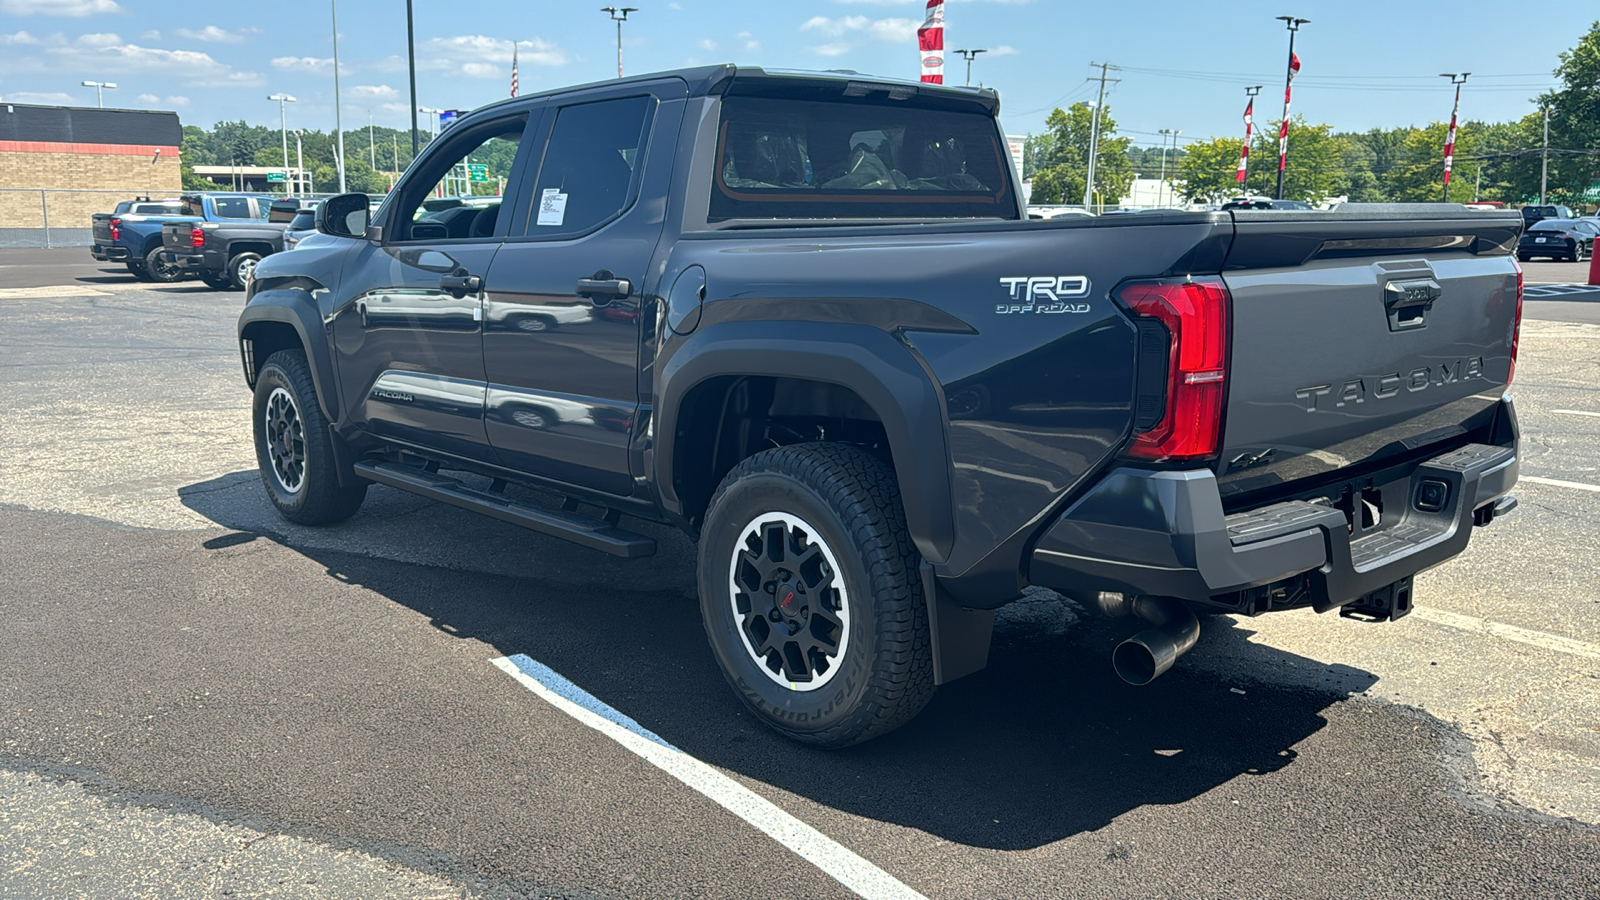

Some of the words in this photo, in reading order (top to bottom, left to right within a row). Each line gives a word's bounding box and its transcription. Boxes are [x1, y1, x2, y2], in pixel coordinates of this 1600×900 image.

[1000, 276, 1091, 303] TRD
[995, 304, 1033, 314] OFF
[1035, 303, 1091, 314] ROAD
[1295, 356, 1484, 412] TACOMA
[373, 389, 414, 402] TACOMA
